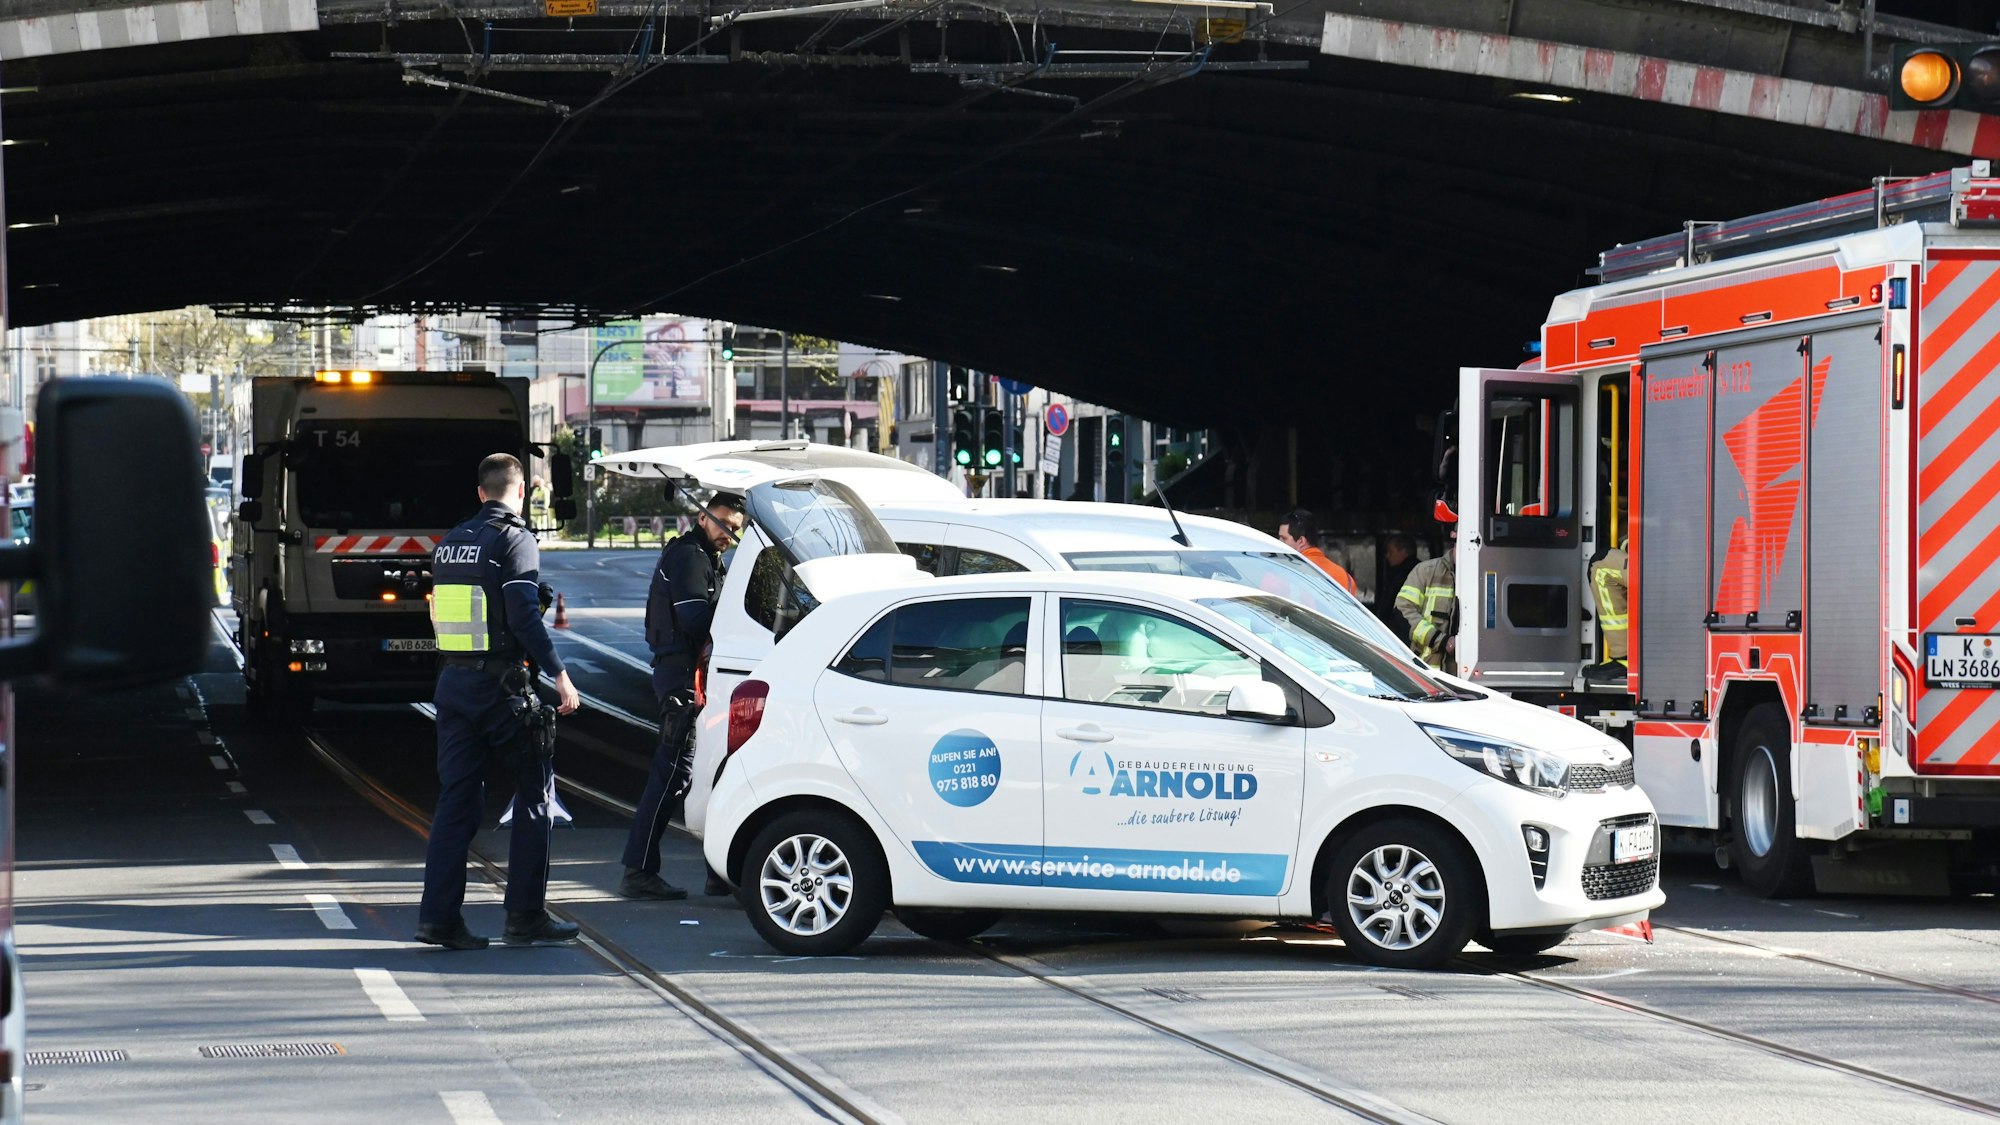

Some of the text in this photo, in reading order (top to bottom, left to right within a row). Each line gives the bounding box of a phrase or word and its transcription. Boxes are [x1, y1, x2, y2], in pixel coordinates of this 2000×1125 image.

[597, 326, 637, 337] ERST
[1648, 361, 1751, 402] Feuerwehr 112
[313, 430, 361, 447] T 54
[586, 467, 593, 478] 2
[434, 545, 481, 564] POLIZEI
[1963, 638, 1973, 656] K
[1932, 659, 2000, 677] LN 3686
[931, 747, 996, 764] RUFEN SIE AN!
[953, 763, 976, 774] 0221
[936, 774, 996, 792] 975 818 80
[1109, 770, 1258, 800] ARNOLD
[1117, 807, 1242, 826] ...die saubere Lösung!
[953, 855, 1241, 882] www.service-arnold.de
